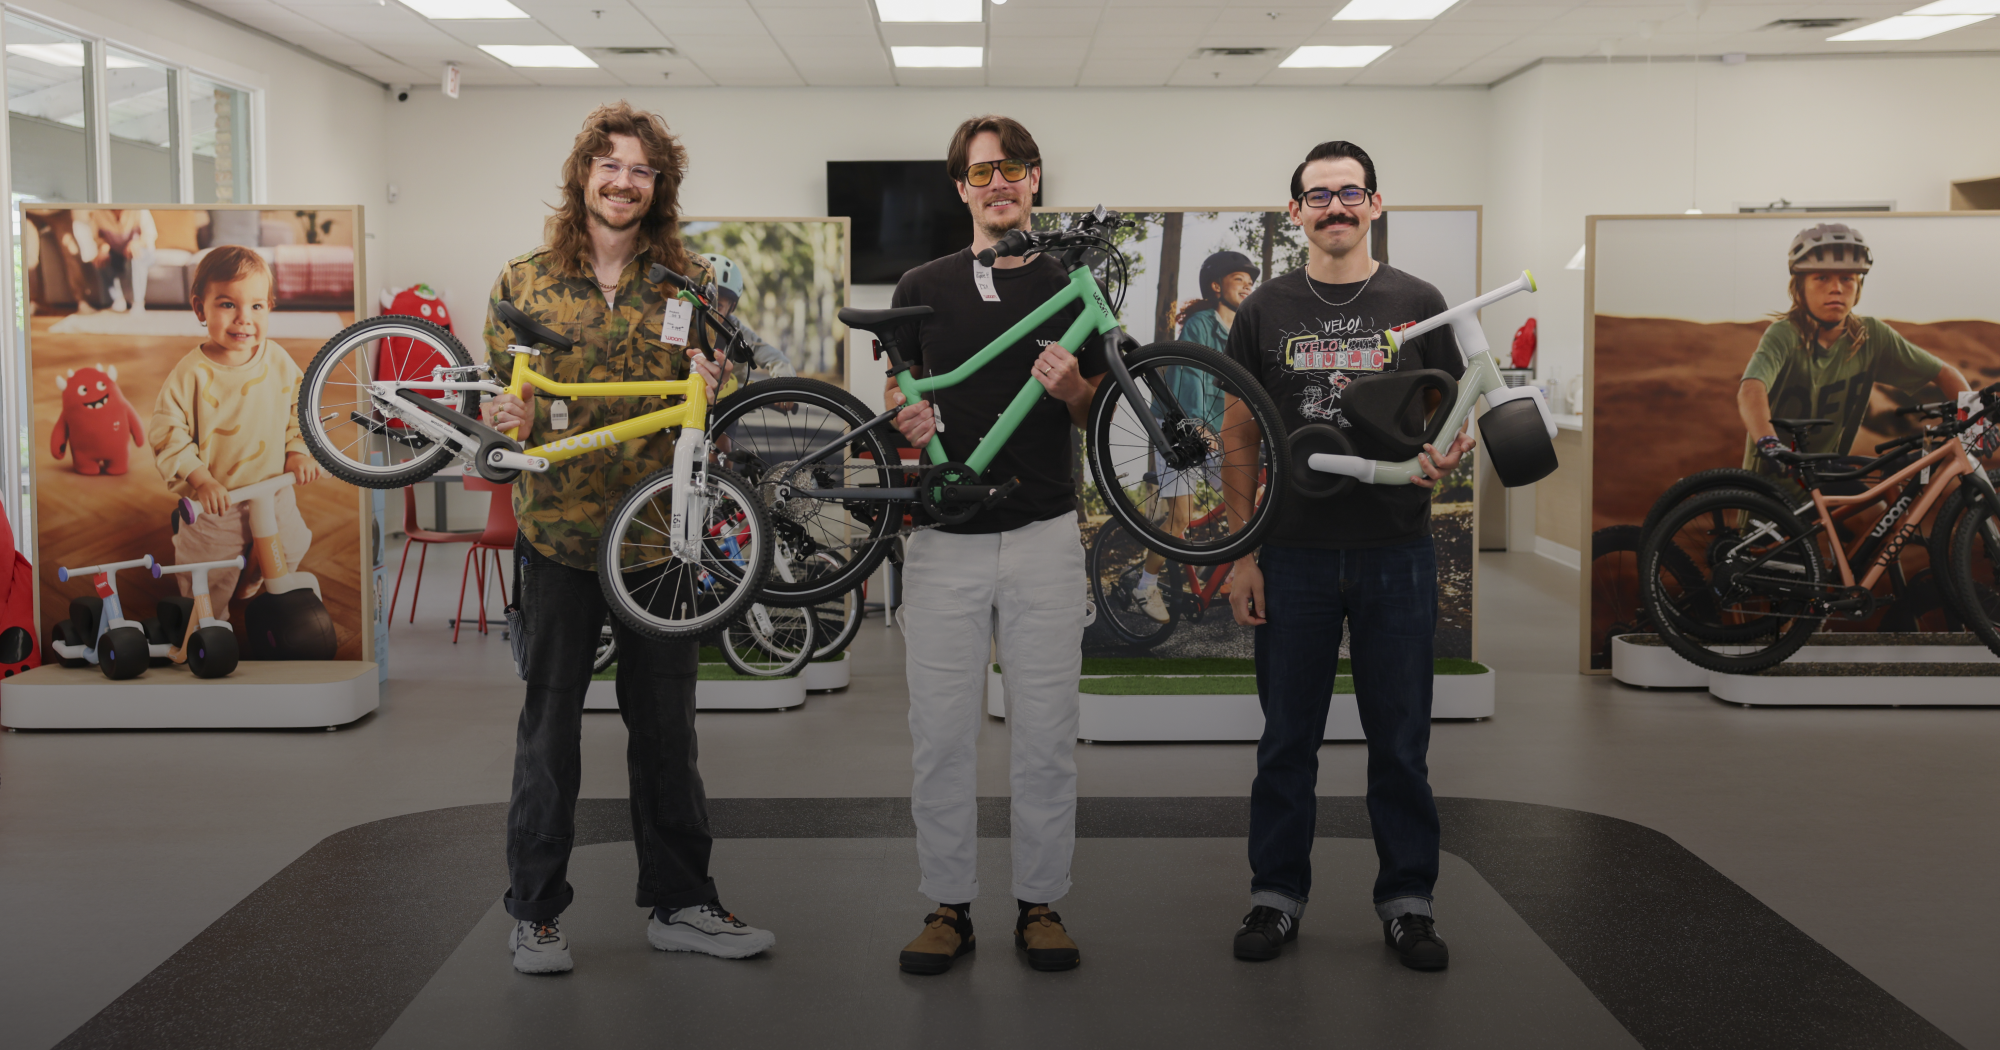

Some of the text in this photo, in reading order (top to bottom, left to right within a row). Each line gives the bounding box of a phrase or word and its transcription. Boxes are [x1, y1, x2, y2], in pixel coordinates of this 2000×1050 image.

[664, 335, 685, 344] woom
[1298, 340, 1339, 353] VELO
[1294, 352, 1384, 369] REPUBLIC
[542, 430, 620, 453] woom
[1870, 495, 1912, 538] woom
[270, 540, 283, 573] woom
[1874, 523, 1918, 567] woom
